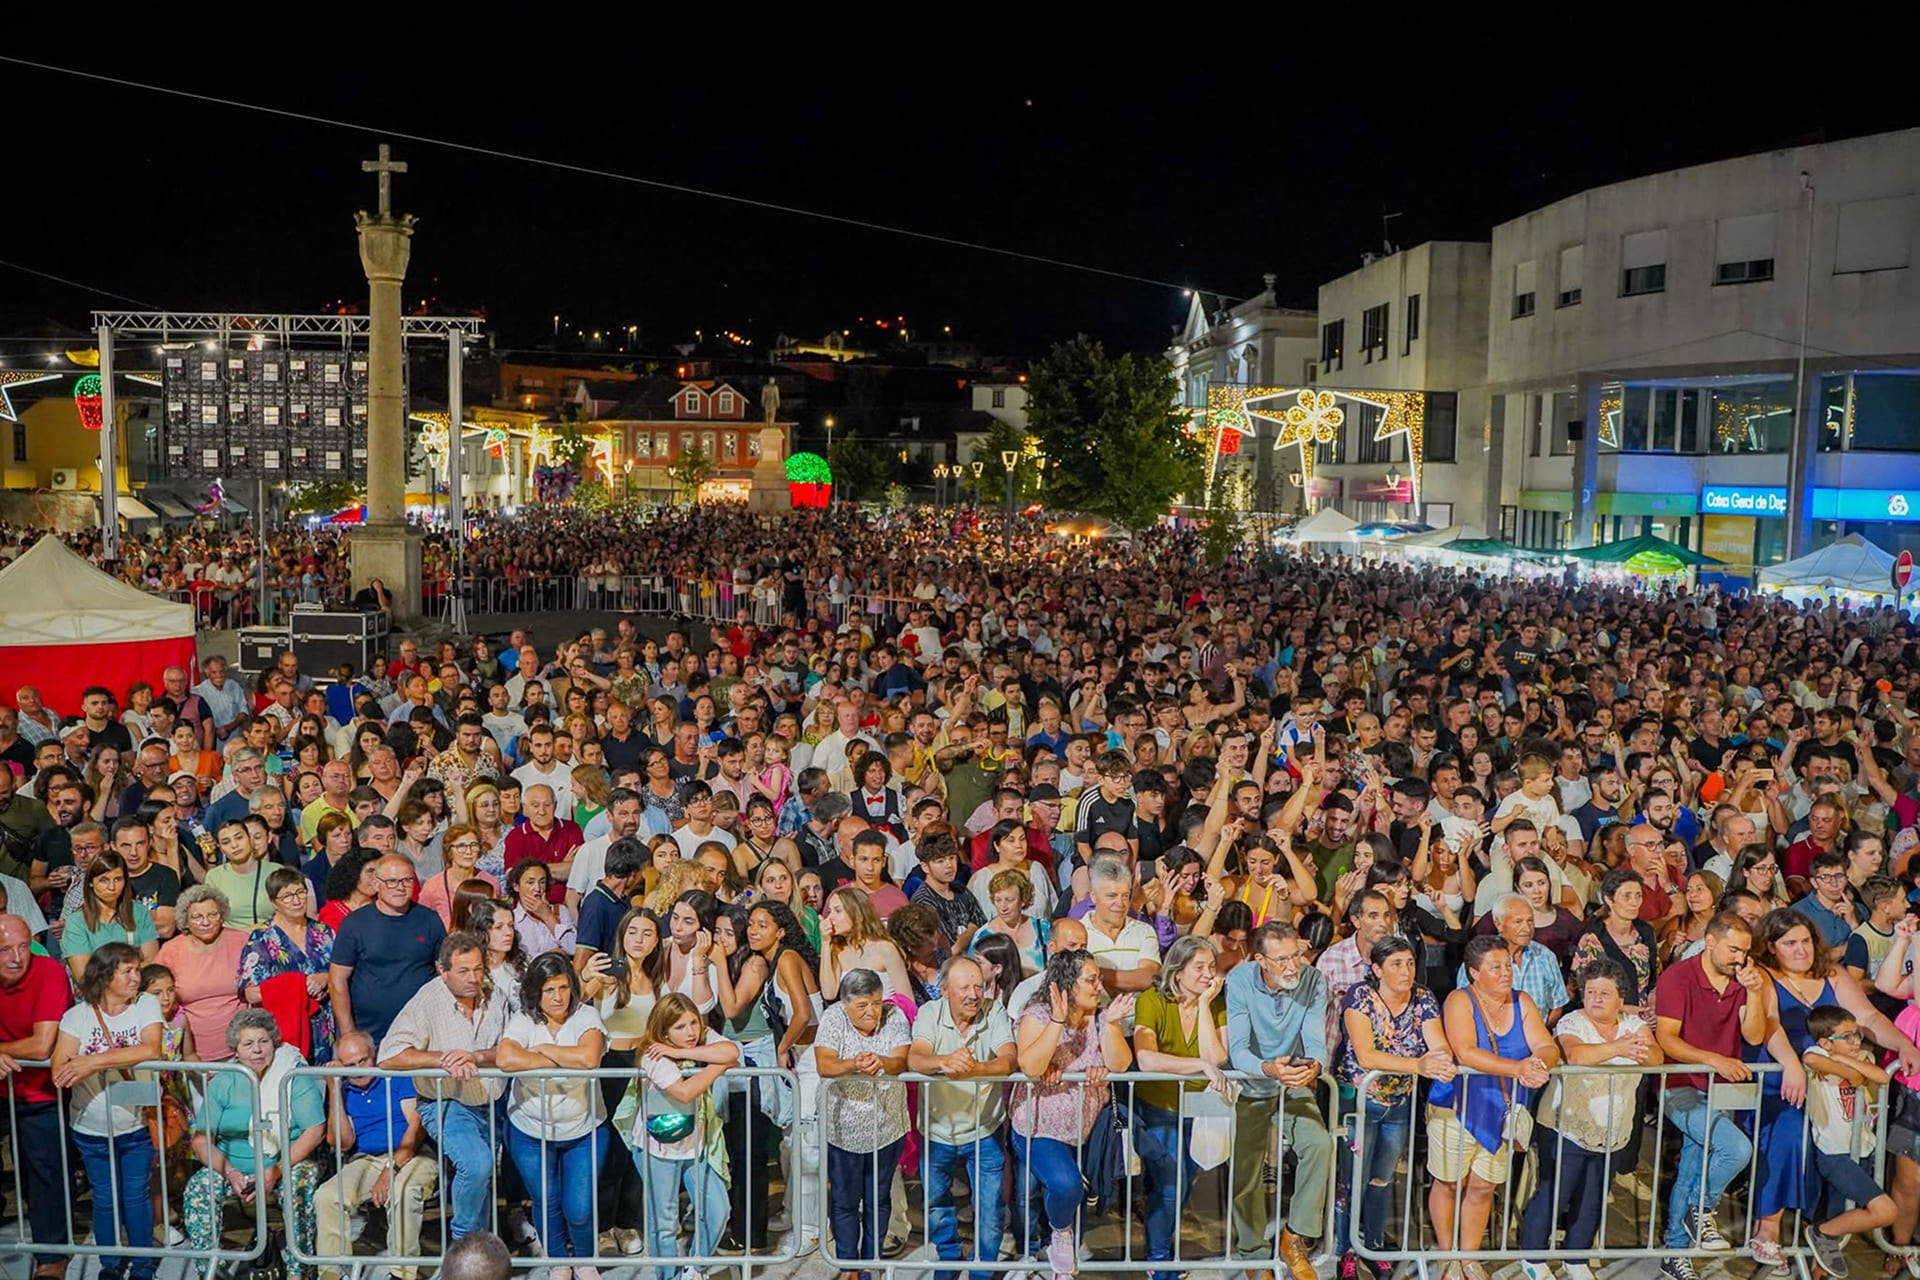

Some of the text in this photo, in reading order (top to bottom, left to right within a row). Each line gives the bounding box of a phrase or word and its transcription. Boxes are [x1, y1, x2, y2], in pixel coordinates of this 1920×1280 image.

[1706, 491, 1730, 508] Caixa
[1731, 492, 1754, 509] Geral
[1755, 494, 1767, 510] de
